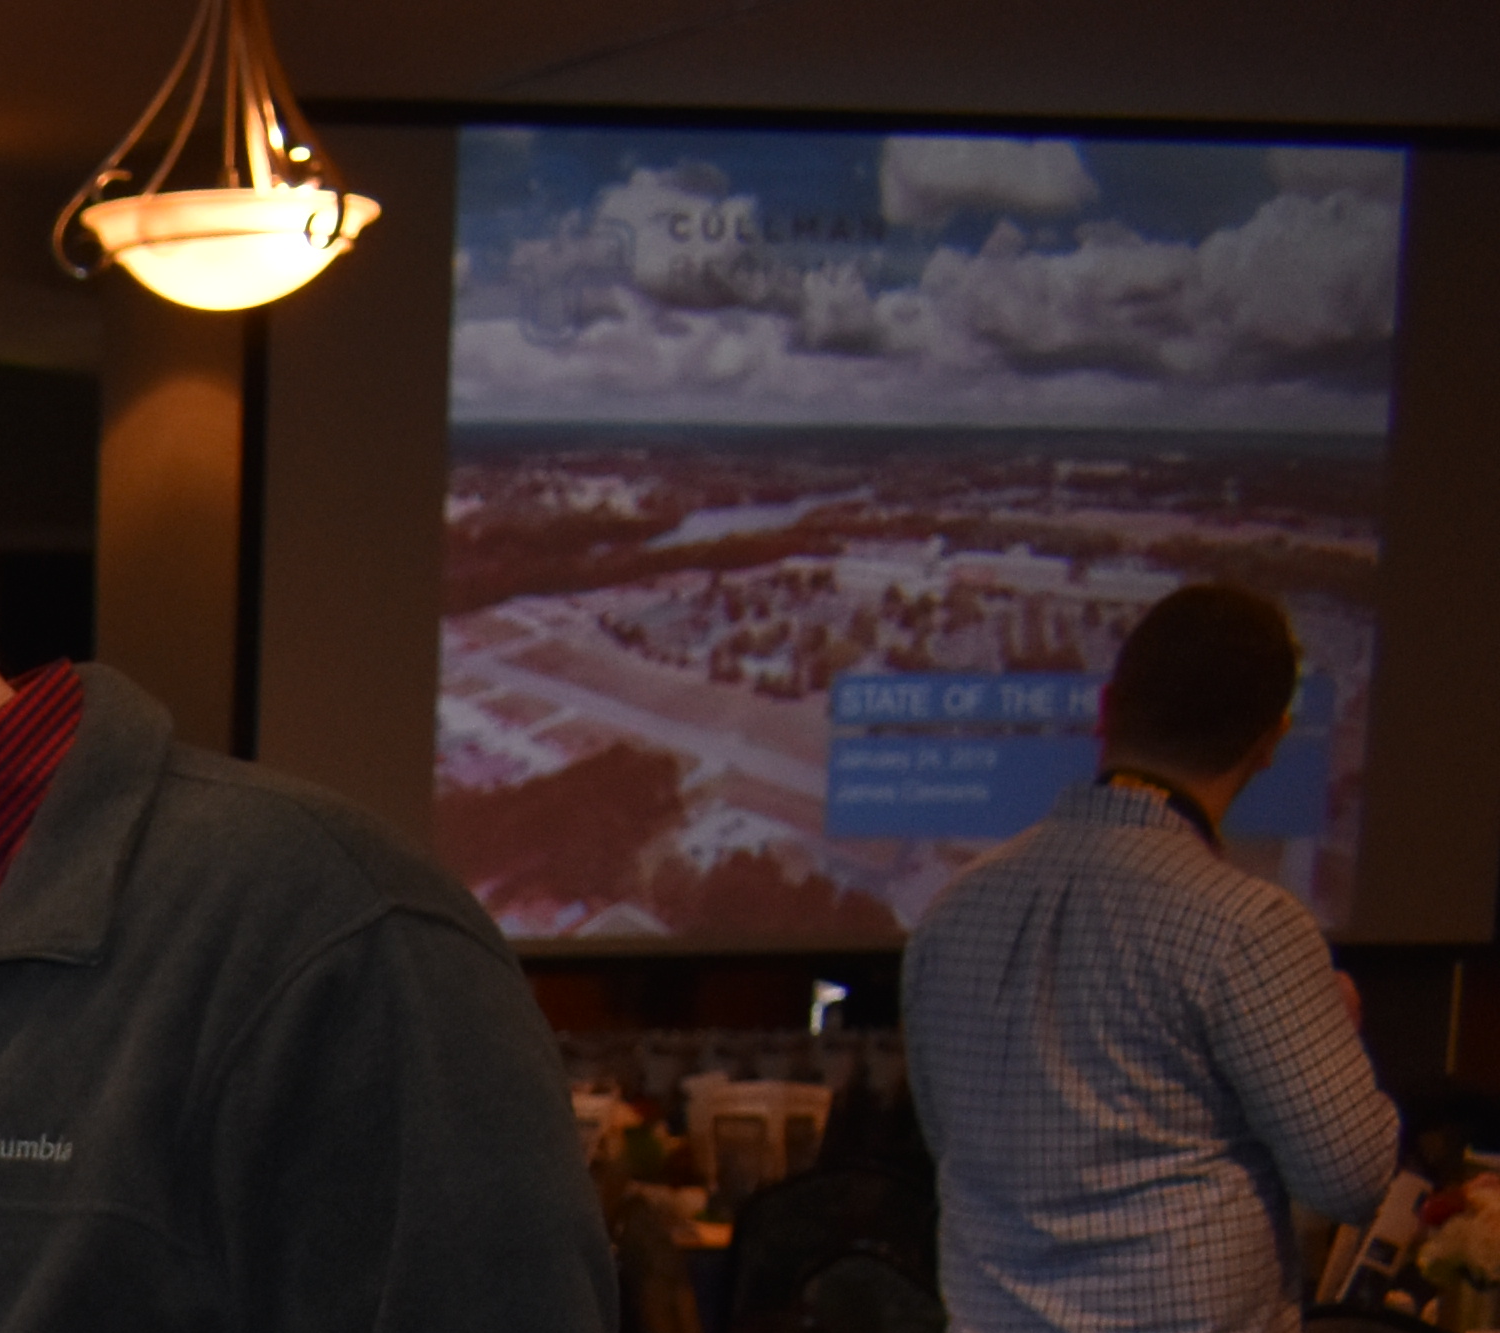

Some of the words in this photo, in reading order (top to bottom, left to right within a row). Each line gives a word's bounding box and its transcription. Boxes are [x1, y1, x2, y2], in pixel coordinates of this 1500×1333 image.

[667, 210, 888, 244] CULLMAN
[838, 682, 932, 717] STATE
[942, 682, 984, 716] OF
[998, 682, 1055, 716] THE
